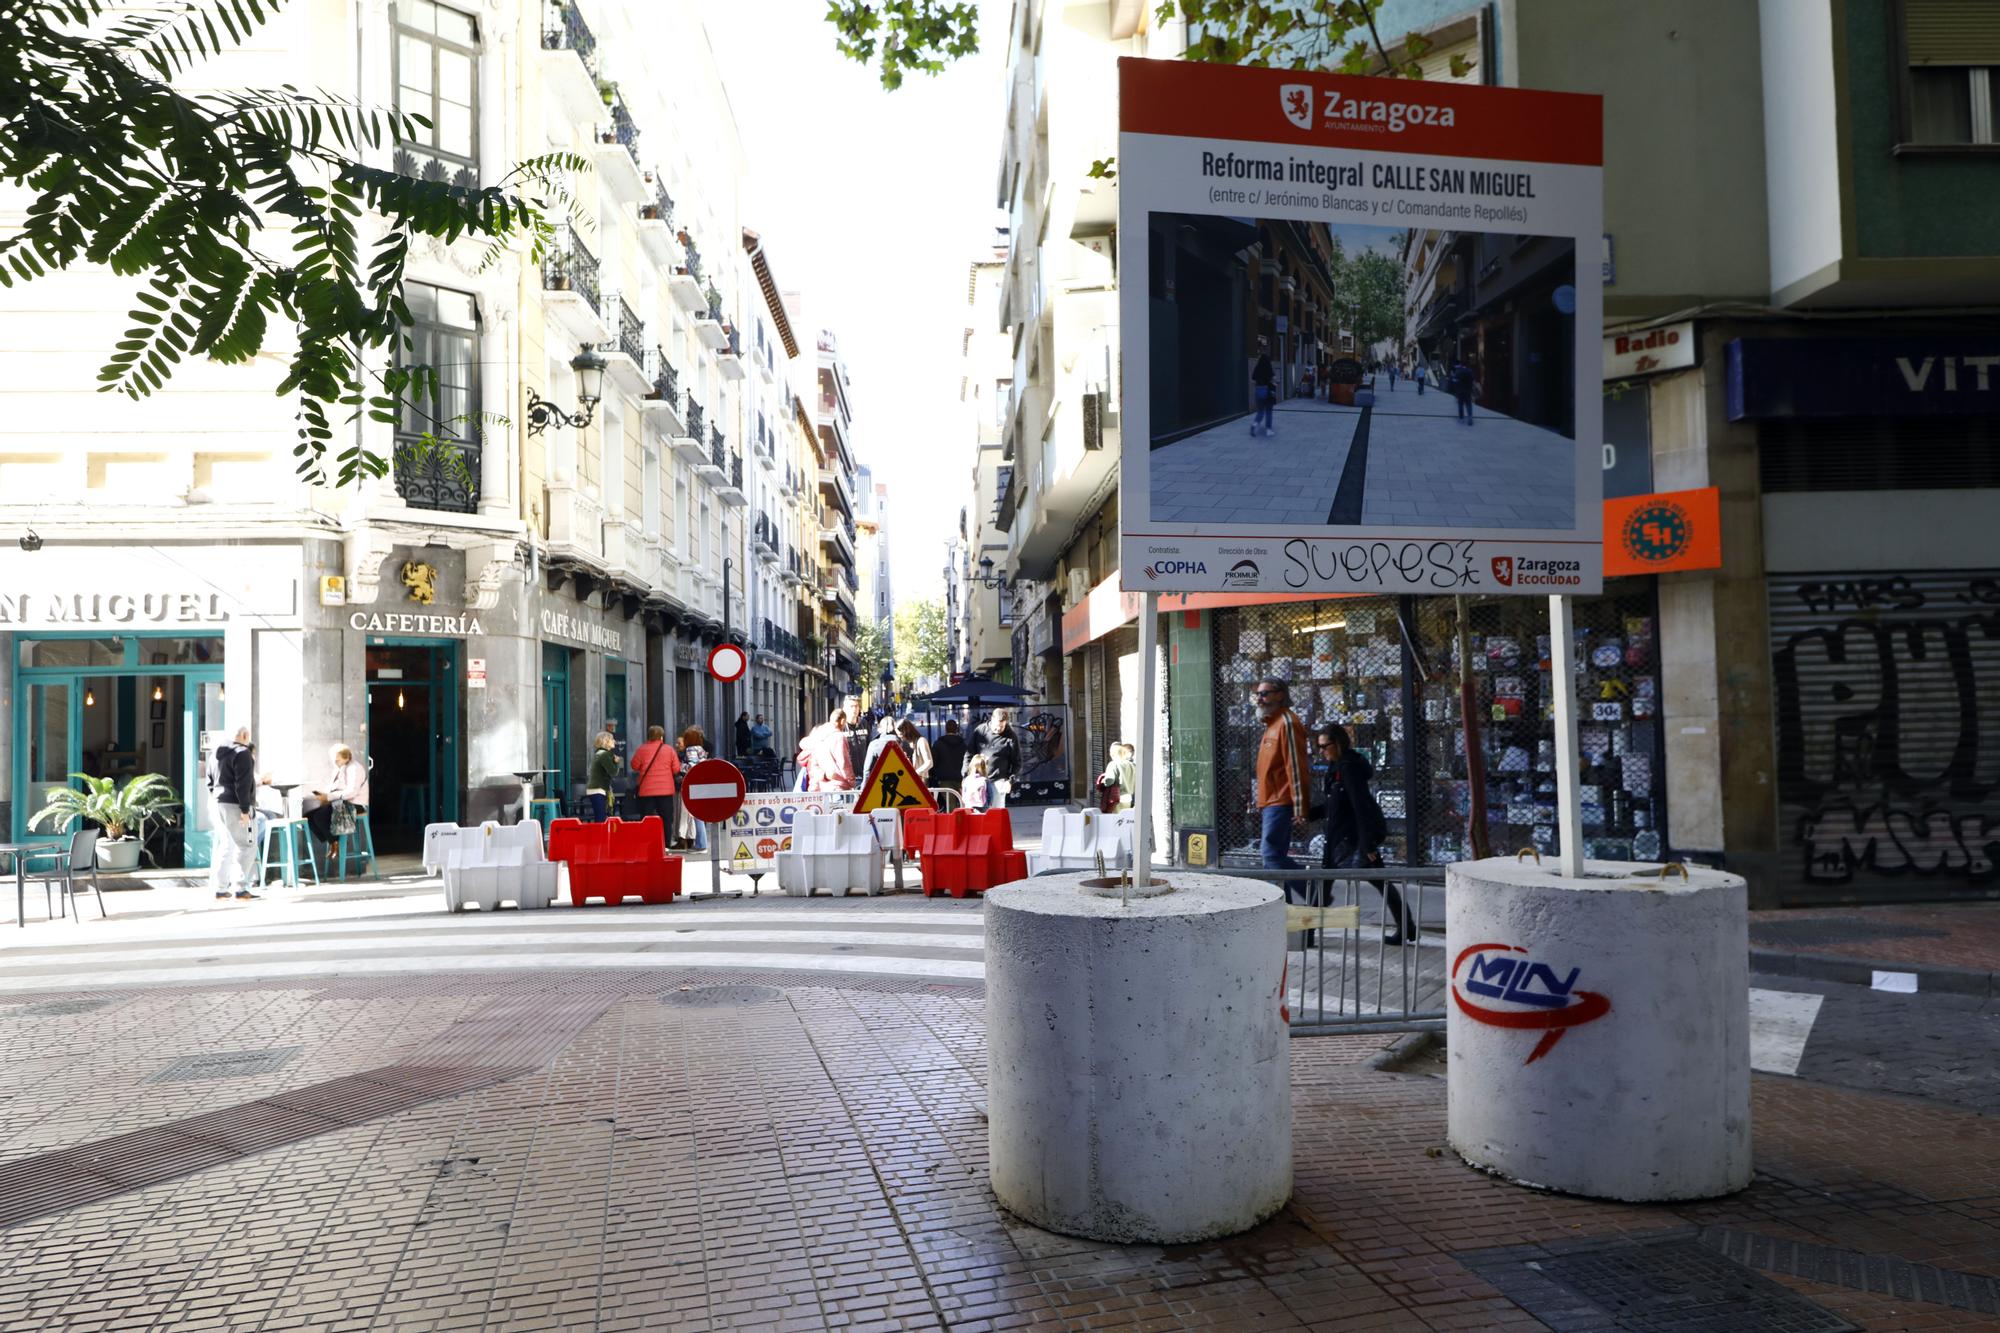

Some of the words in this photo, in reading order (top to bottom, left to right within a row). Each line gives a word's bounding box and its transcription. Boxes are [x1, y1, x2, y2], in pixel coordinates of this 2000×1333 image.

[1324, 90, 1455, 132] Zaragoza
[1324, 121, 1386, 133] AYUNTAMIENTO
[1202, 151, 1284, 181] Reforma
[1289, 156, 1364, 191] integral
[1372, 163, 1425, 191] CALLE
[1429, 167, 1465, 194] SAN
[1469, 171, 1536, 199] MIGUEL
[1208, 186, 1245, 204] (entre
[1248, 190, 1261, 204] c/
[1264, 190, 1319, 209] Jerónimo
[1322, 194, 1369, 212] Blancas
[1371, 201, 1379, 216] y
[1382, 200, 1393, 214] c/
[1397, 199, 1471, 219] Comandante
[1474, 204, 1528, 224] Repollés)
[1615, 329, 1680, 355] Radio
[1896, 356, 2000, 392] VIT
[1154, 561, 1207, 574] COPHA
[1225, 571, 1259, 579] PROIMUR
[1517, 557, 1580, 576] Zaragoza
[1517, 573, 1581, 585] ECOCIUDAD
[45, 593, 230, 624] MIGUEL
[350, 612, 484, 635] CAFETERÍA
[571, 618, 589, 643] SAN
[591, 622, 621, 652] MIGUEL
[758, 845, 777, 854] STOP
